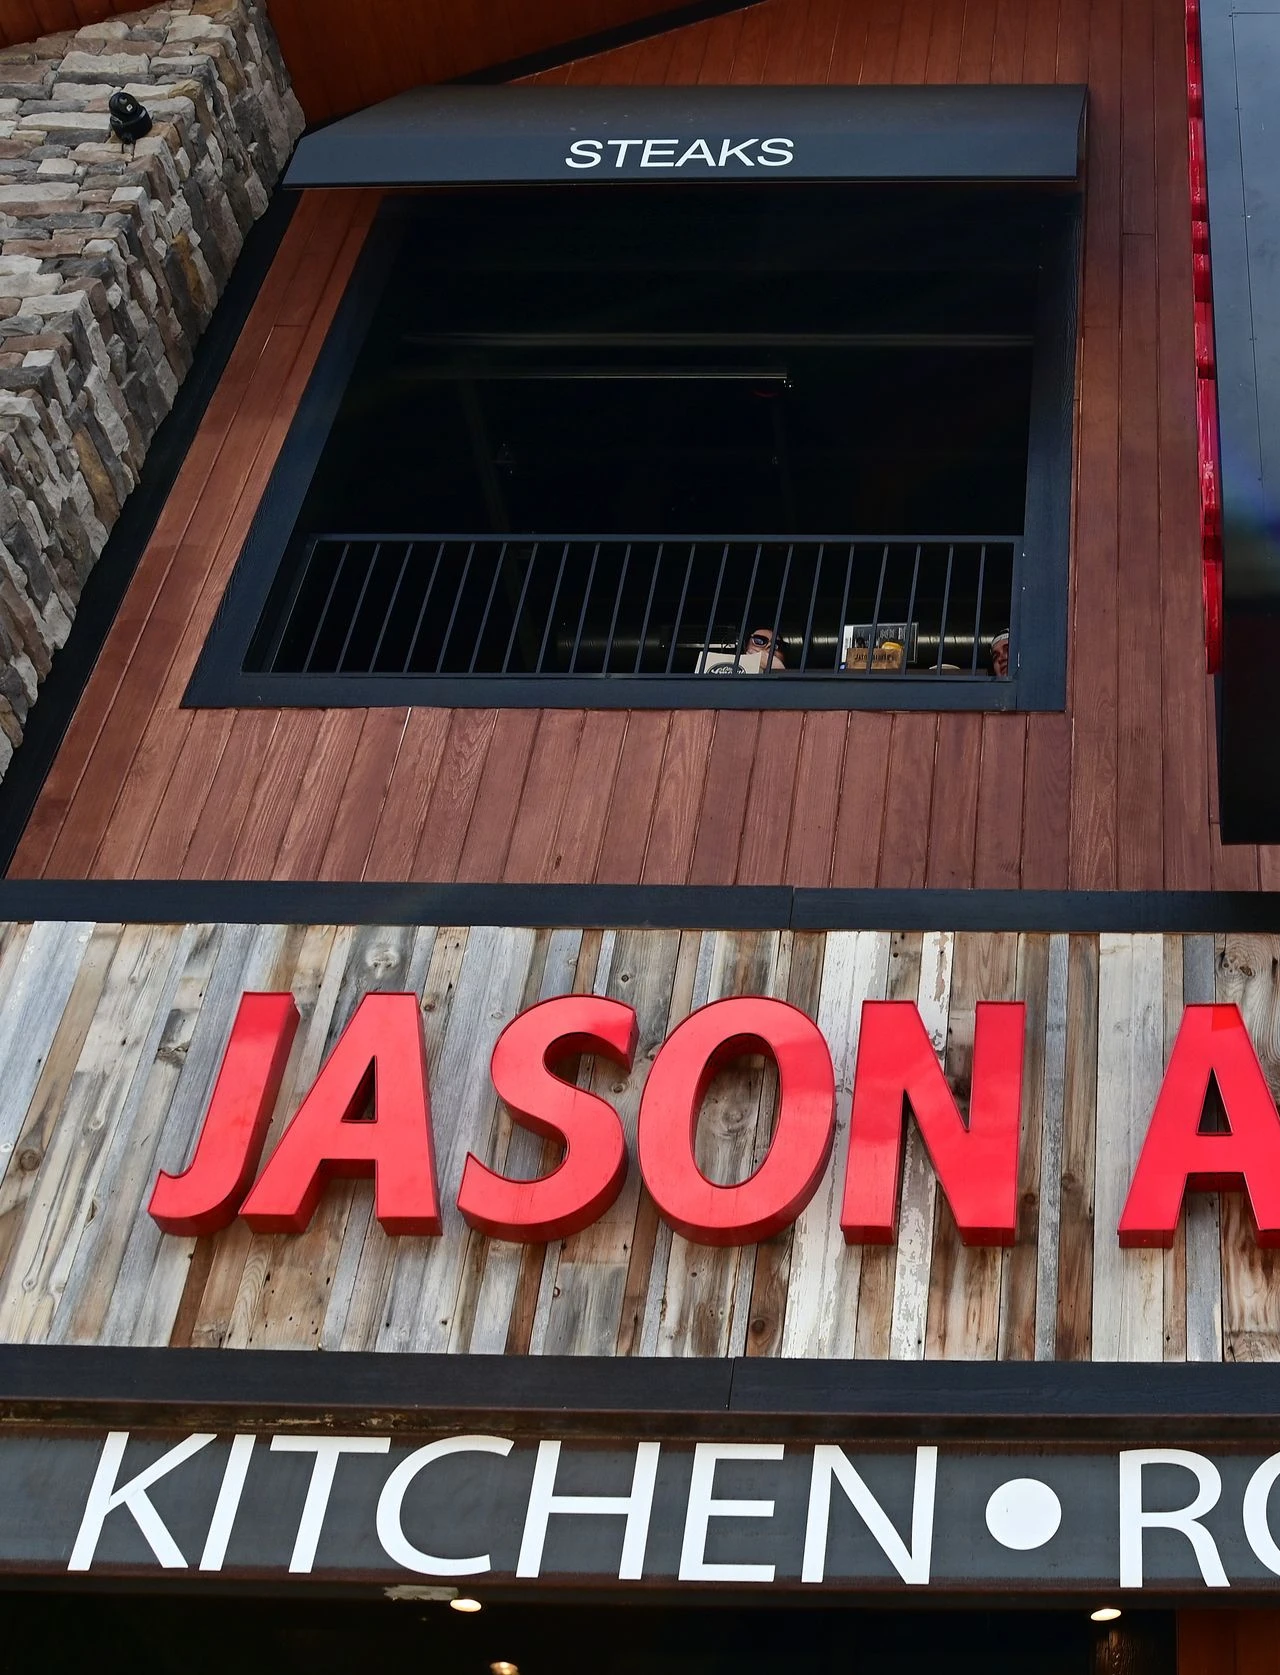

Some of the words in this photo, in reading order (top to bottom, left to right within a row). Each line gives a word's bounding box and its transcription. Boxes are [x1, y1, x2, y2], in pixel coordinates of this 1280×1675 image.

[565, 138, 794, 169] STEAKS
[148, 991, 1028, 1247] JASON
[67, 1431, 938, 1586] KITCHEN
